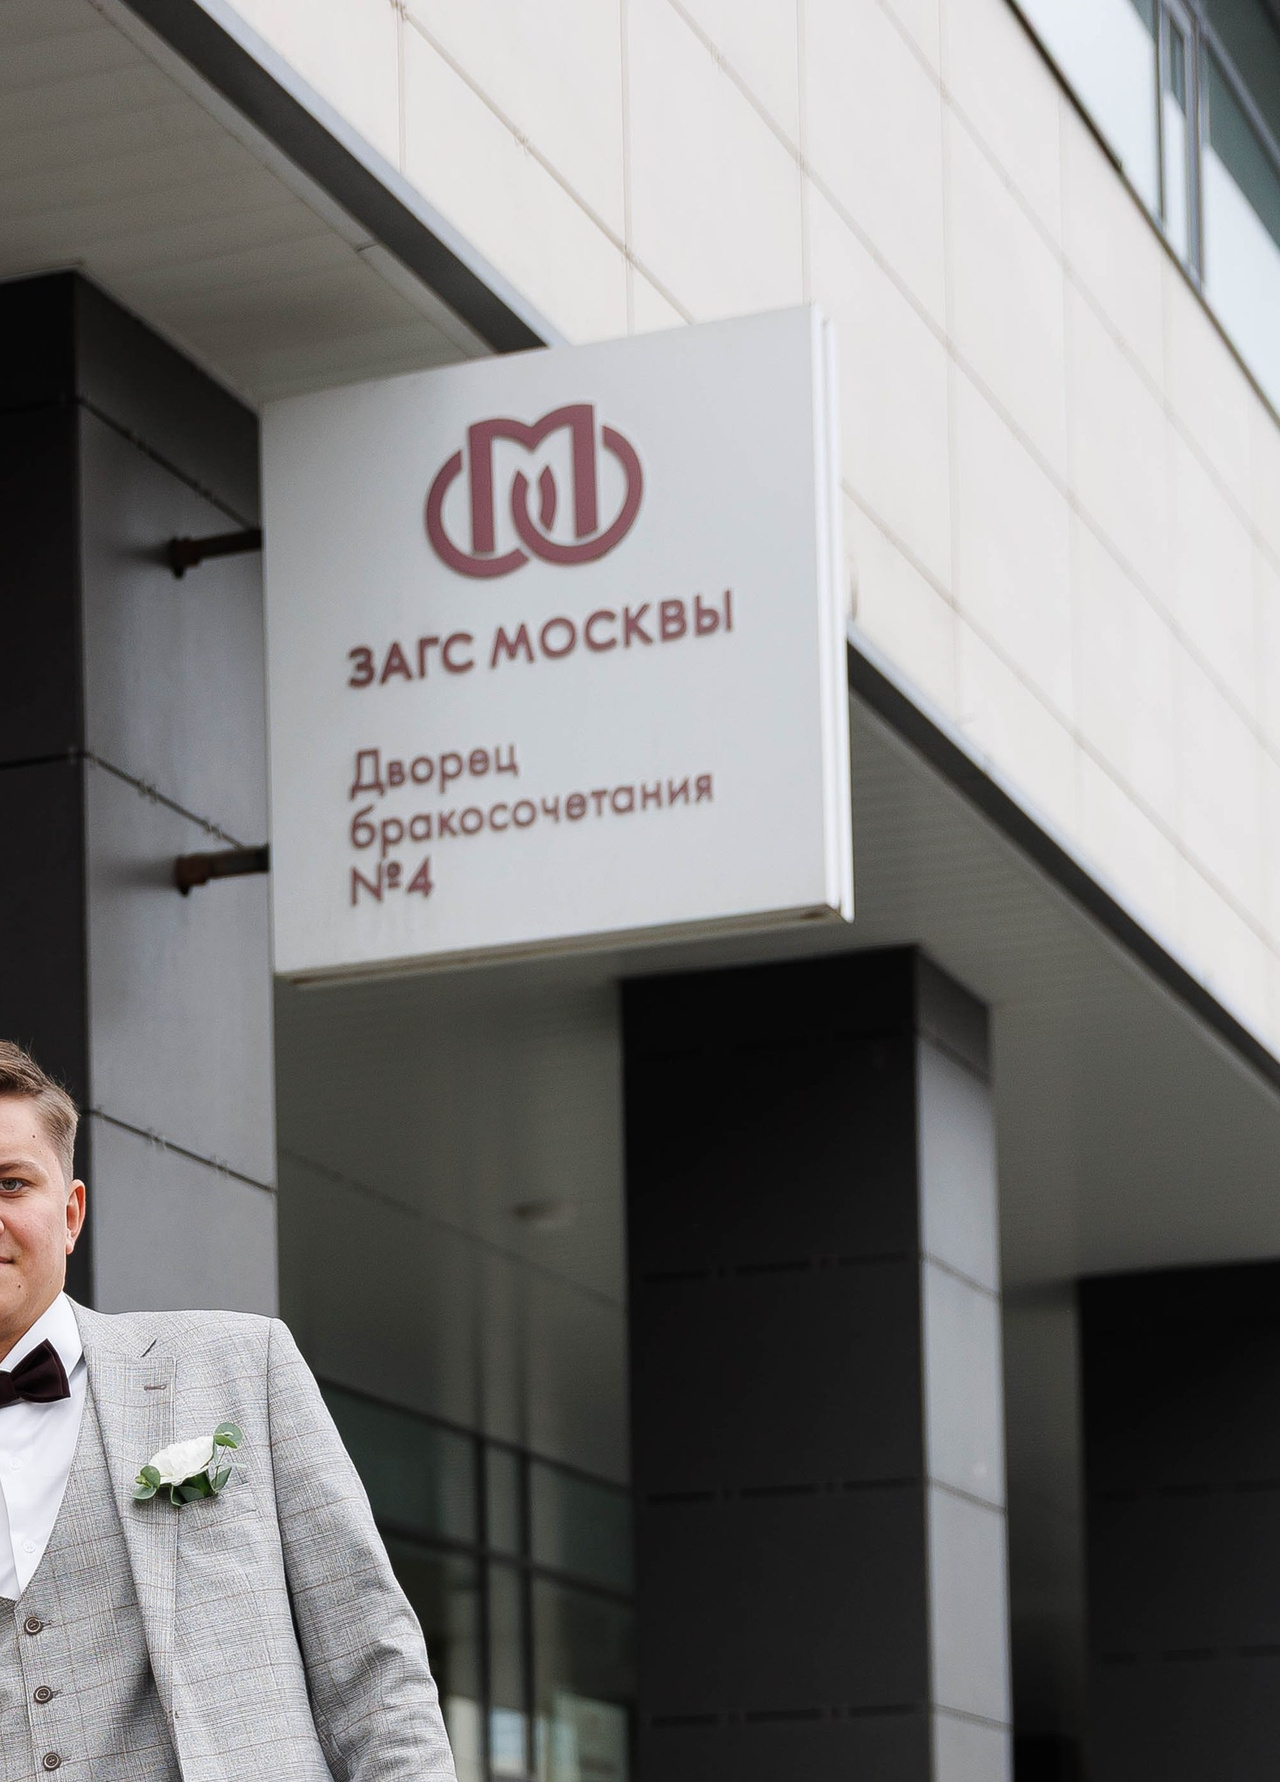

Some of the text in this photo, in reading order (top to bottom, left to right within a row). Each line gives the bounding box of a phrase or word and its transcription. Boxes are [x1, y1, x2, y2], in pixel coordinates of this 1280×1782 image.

[347, 589, 734, 690] ЗАГС МОСКВЫ
[348, 747, 519, 800] Дворец
[348, 774, 714, 859] бракосочетания
[349, 859, 434, 906] №4
